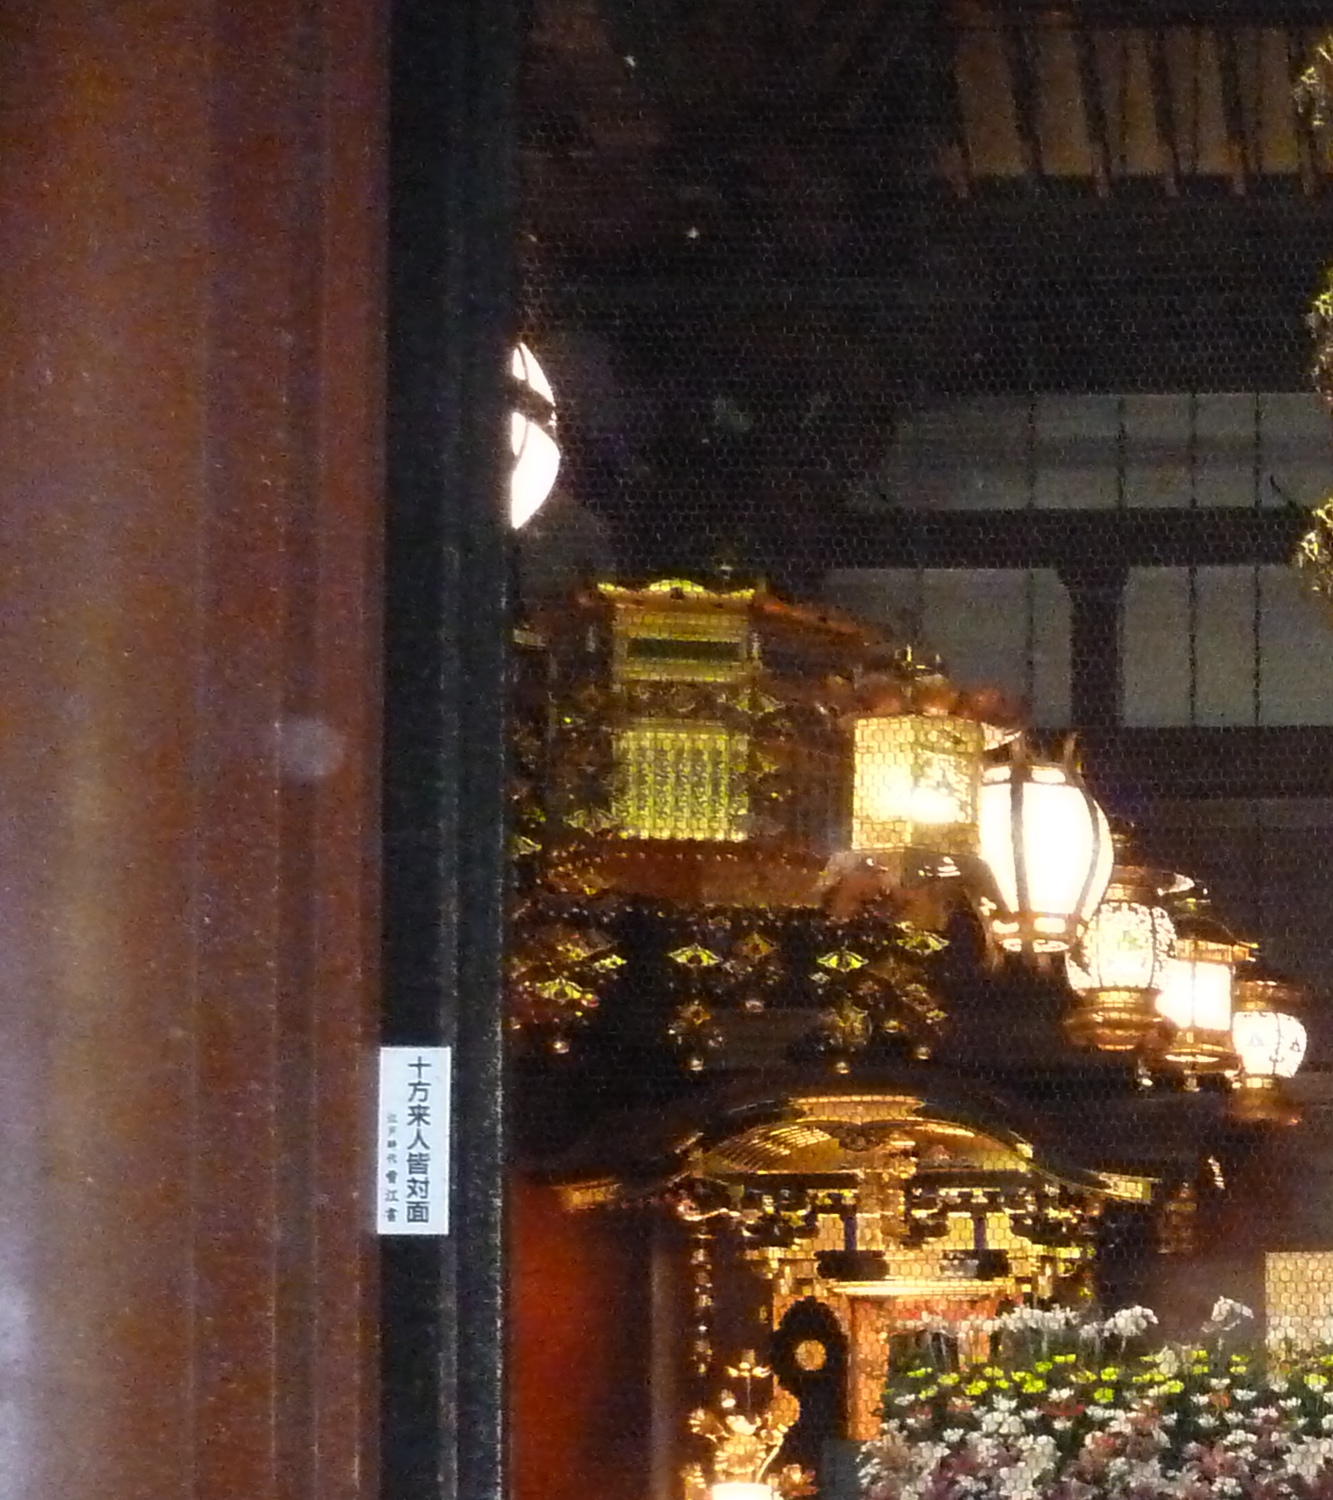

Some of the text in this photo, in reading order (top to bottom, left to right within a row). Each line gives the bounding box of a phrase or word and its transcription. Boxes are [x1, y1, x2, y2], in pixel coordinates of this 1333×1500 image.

[406, 1056, 431, 1223] 十方来人皆対面
